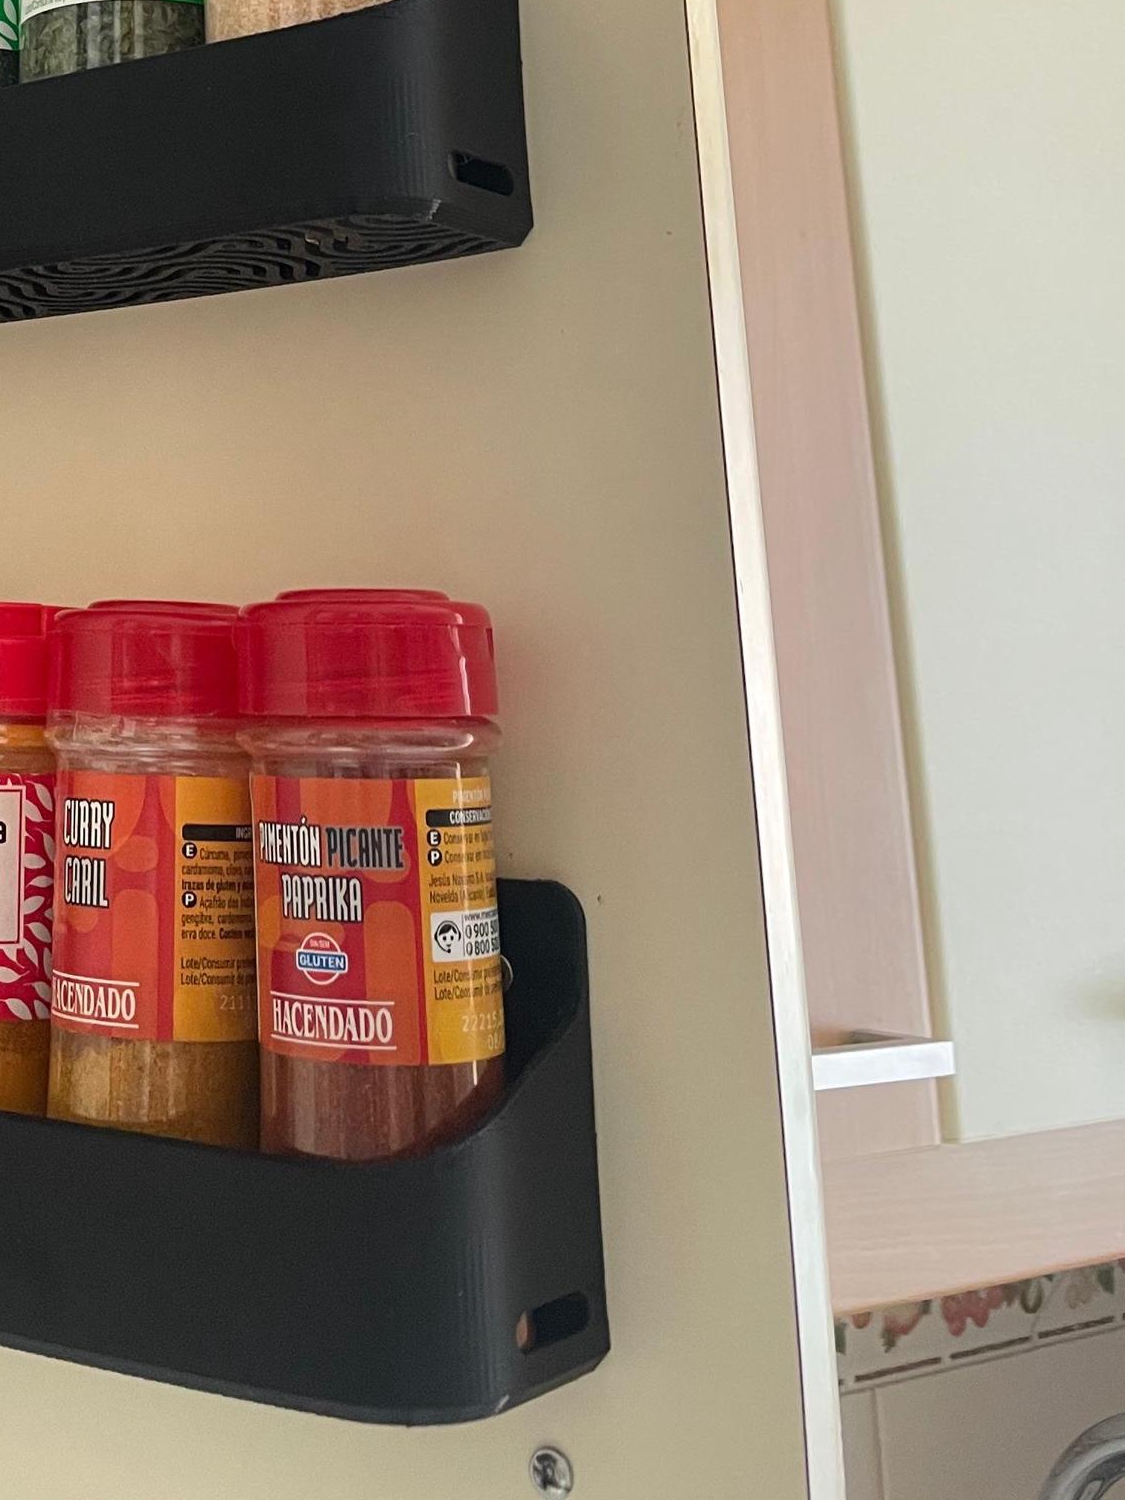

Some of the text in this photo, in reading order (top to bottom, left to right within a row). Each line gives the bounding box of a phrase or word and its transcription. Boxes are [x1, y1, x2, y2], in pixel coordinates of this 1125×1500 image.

[64, 799, 114, 848] CURRY
[259, 817, 321, 867] PIMENTÓN
[326, 827, 404, 869] PICANTE
[65, 857, 109, 907] CARIL
[282, 874, 363, 922] PAPRIKA
[429, 873, 451, 888] Jesús
[474, 921, 489, 937] 900
[475, 938, 490, 954] 800
[299, 954, 345, 969] GLUTEN
[273, 998, 393, 1043] HACENDADO
